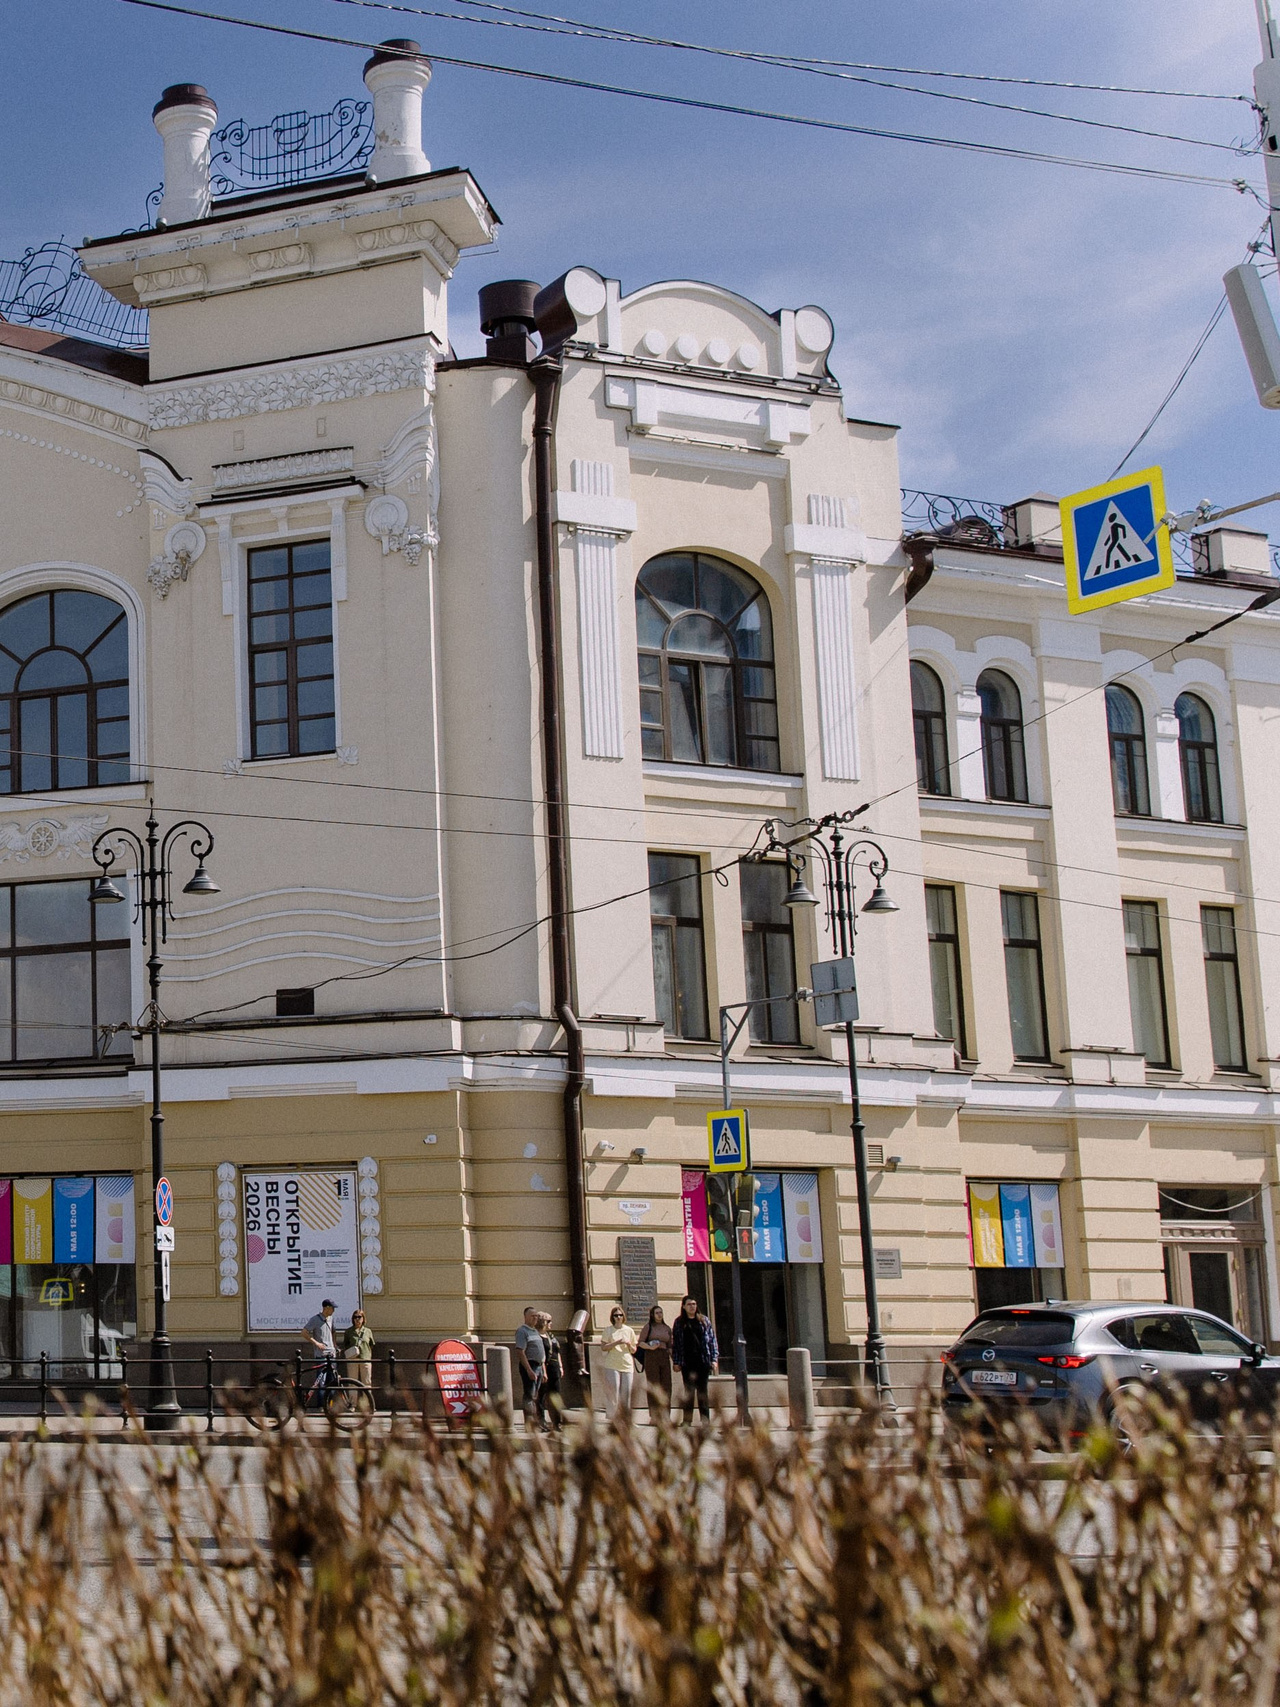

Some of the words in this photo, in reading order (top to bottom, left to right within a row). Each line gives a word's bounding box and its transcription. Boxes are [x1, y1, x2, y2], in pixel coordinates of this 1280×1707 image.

[246, 1181, 261, 1232] 2026
[265, 1181, 281, 1255] ВЕСНЫ
[761, 1199, 770, 1226] 12:00
[683, 1198, 694, 1257] ОТКРЫТИЕ
[1013, 1208, 1022, 1234] 12:00
[285, 1180, 302, 1295] ОТКРЫТИЕ
[763, 1229, 771, 1251] МАЯ
[1015, 1235, 1023, 1257] МАЯ
[256, 1317, 279, 1325] МОСТ
